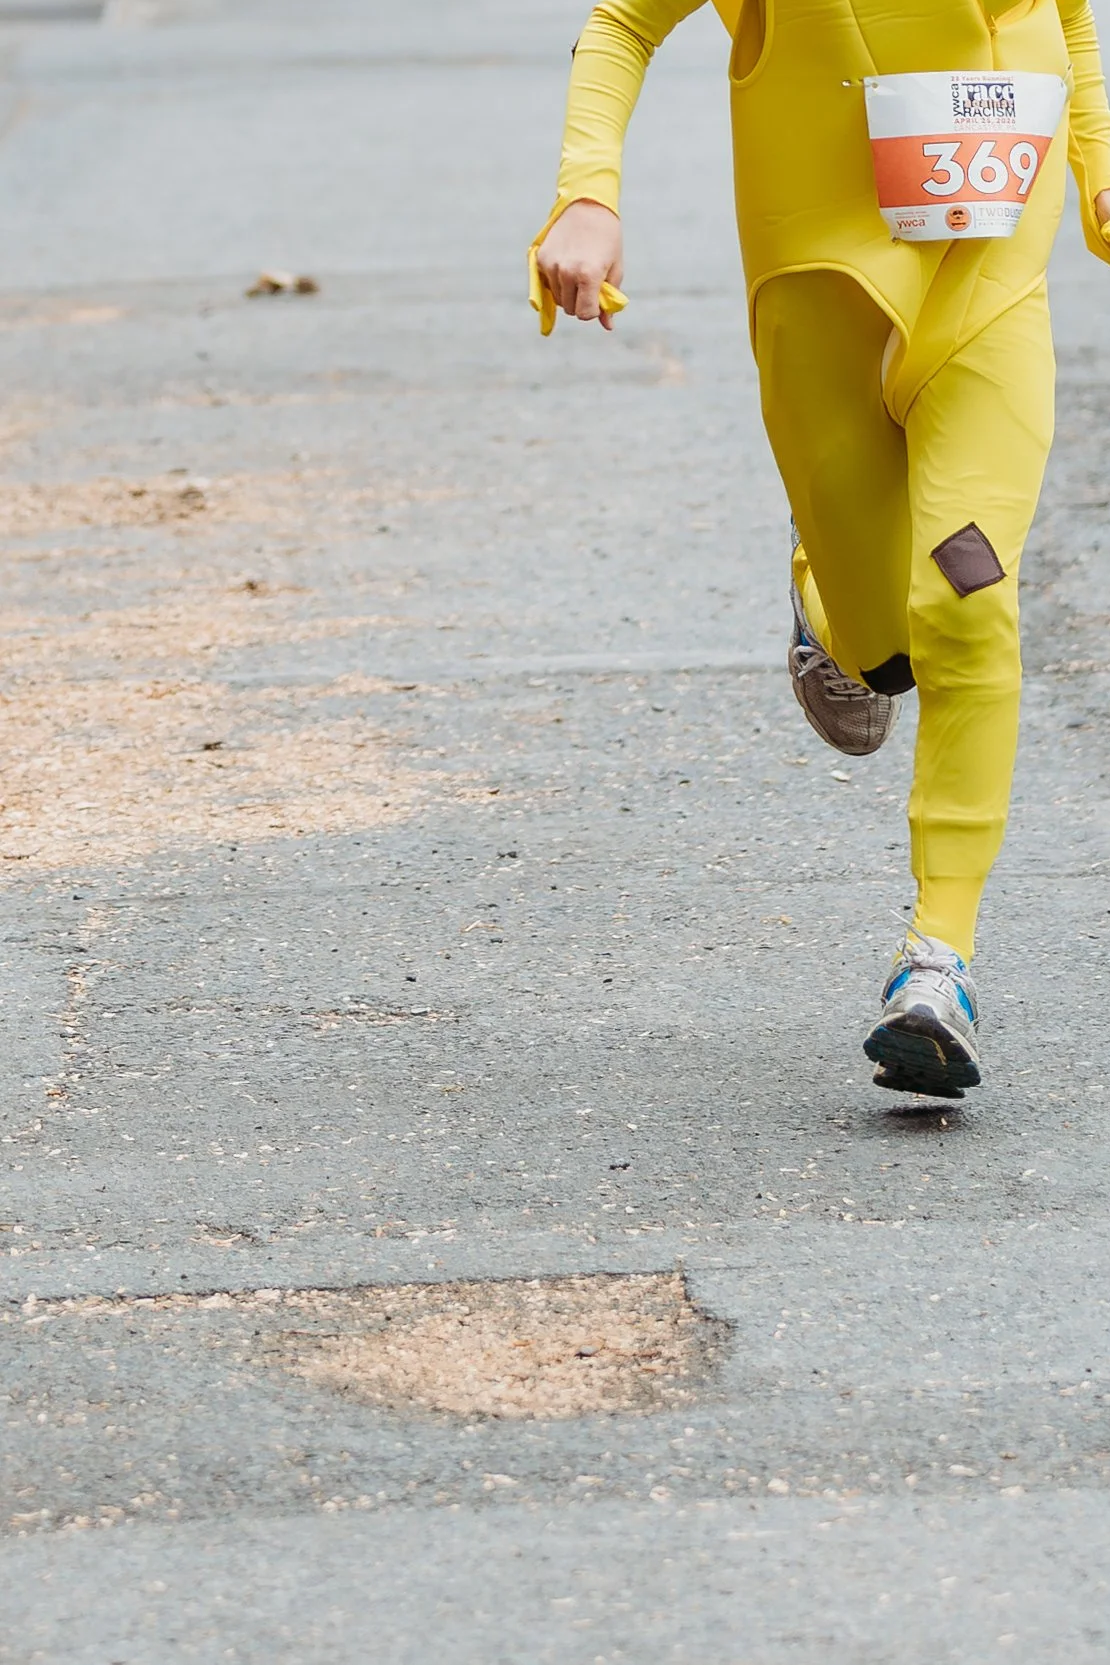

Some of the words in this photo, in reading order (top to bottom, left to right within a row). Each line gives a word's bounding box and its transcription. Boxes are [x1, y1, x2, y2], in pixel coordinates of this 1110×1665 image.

[951, 84, 964, 116] ywca
[962, 84, 1014, 101] race
[963, 105, 1016, 117] RACISM
[921, 140, 1039, 196] 369
[896, 219, 926, 229] ywca
